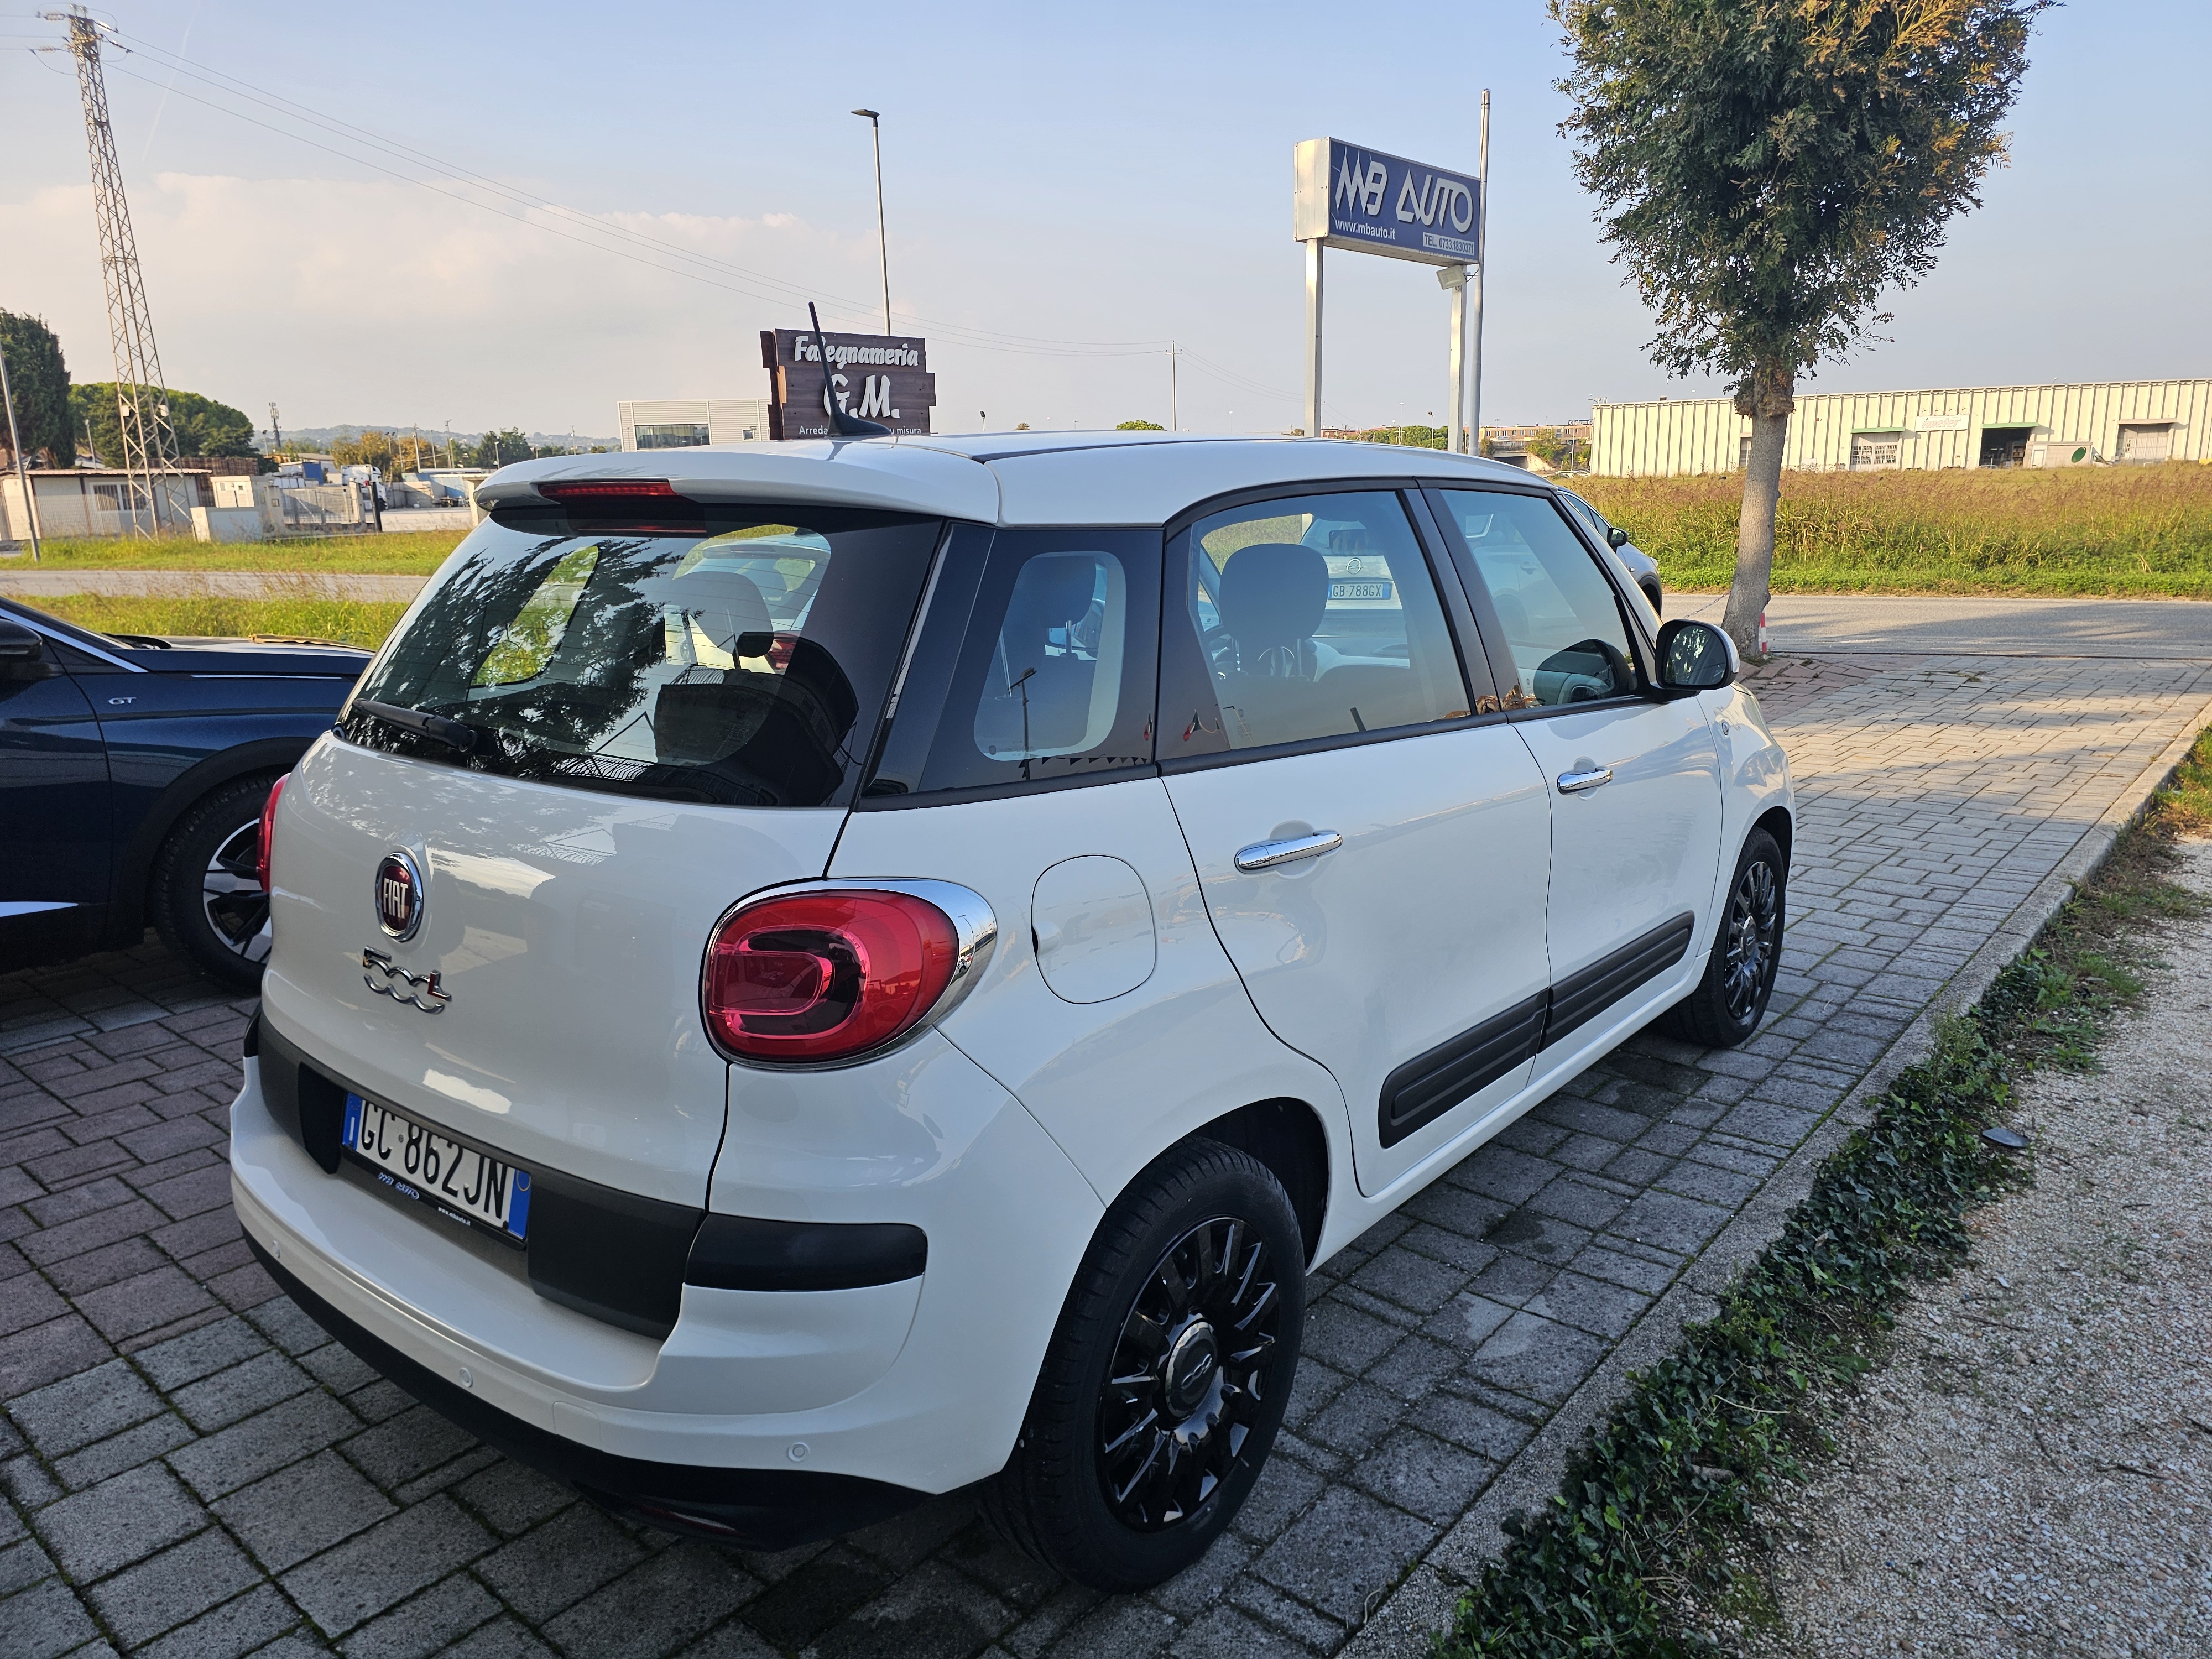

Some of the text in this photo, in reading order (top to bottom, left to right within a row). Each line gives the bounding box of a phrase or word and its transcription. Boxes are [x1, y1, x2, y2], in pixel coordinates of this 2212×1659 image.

[1335, 149, 1473, 232] MB AUTO
[1335, 220, 1396, 240] www.mbauto.it
[1424, 234, 1474, 254] TEL. 0733.1830371
[823, 373, 900, 419] G.M.
[896, 425, 921, 434] misura
[383, 878, 409, 919] FIAT
[363, 945, 451, 1015] 500L
[378, 1172, 419, 1199] MB AUTO
